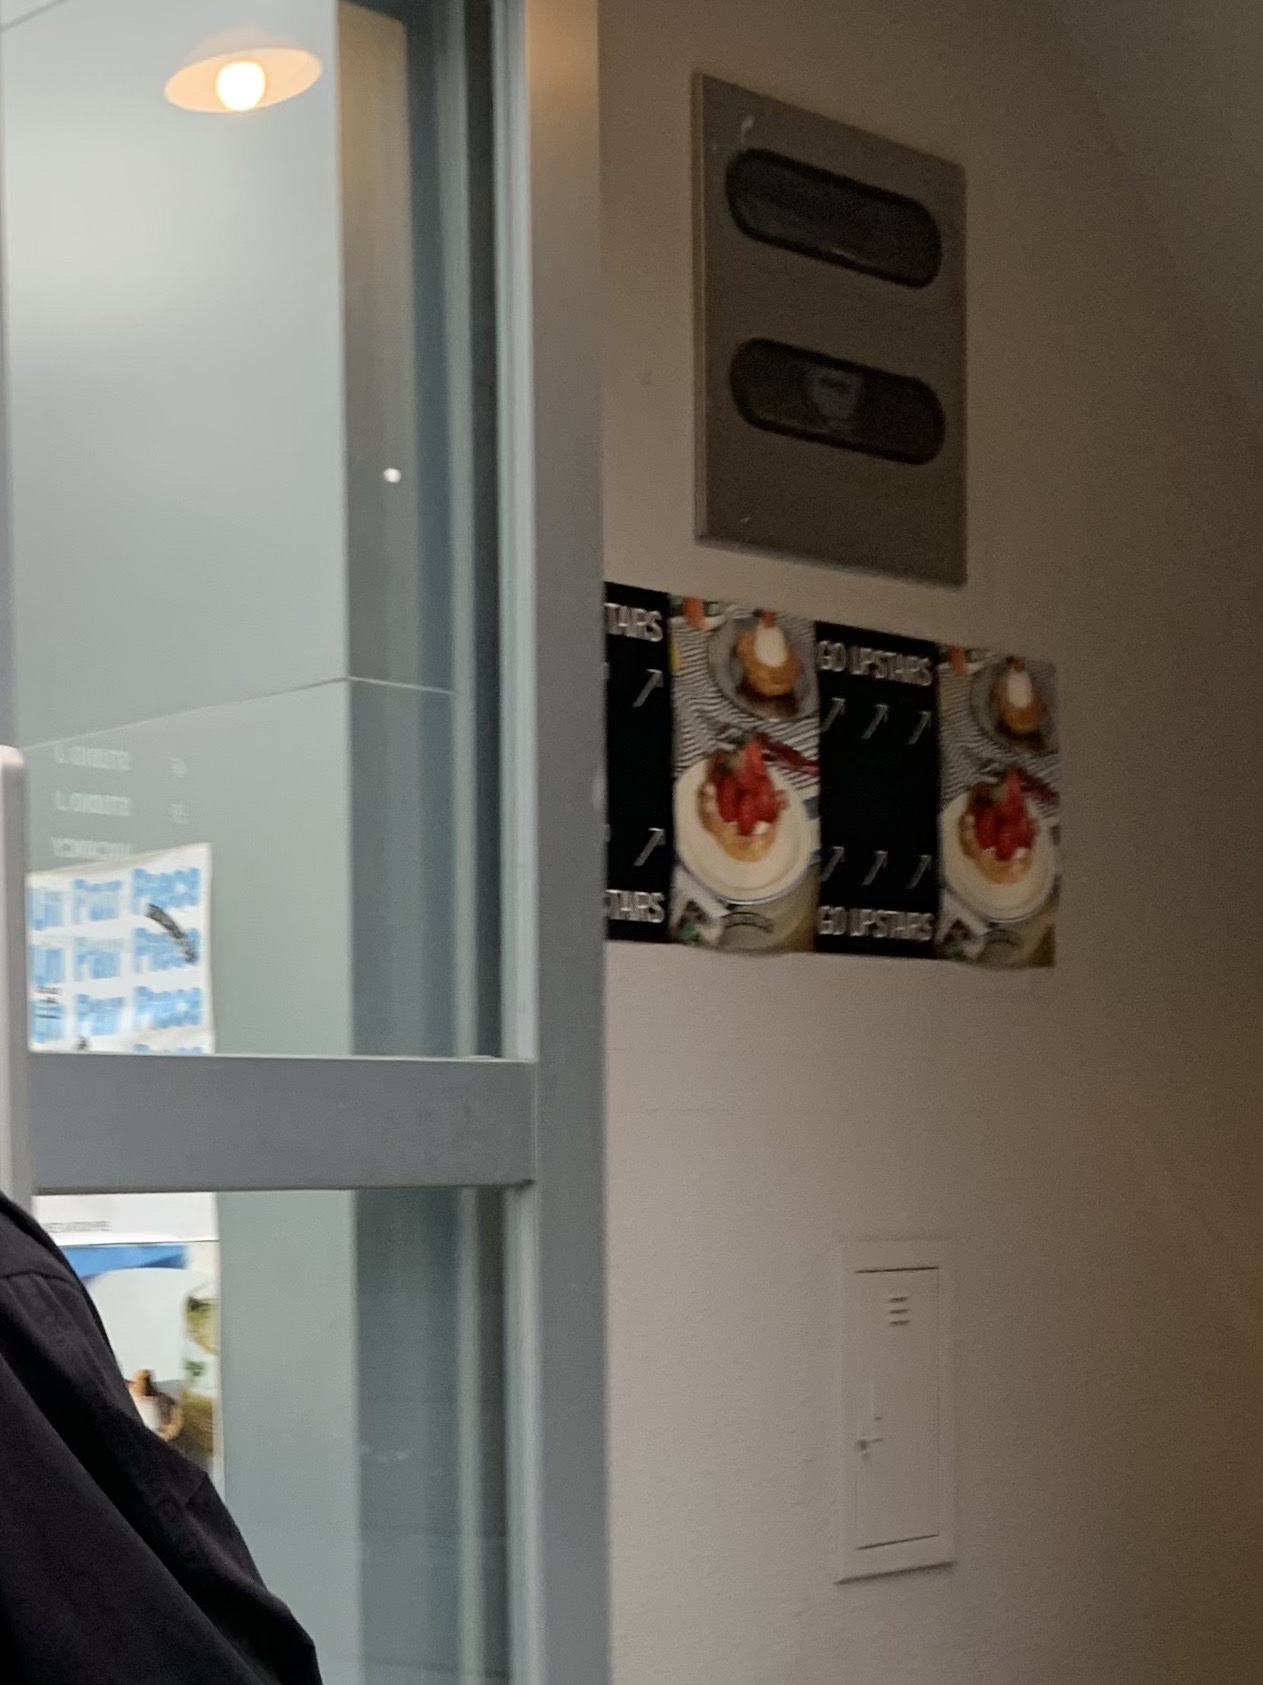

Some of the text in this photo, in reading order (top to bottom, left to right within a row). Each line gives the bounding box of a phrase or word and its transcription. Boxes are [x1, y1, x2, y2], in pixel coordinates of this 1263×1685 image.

[817, 640, 934, 687] GO UPSTAIRS
[817, 905, 934, 942] GO UPSTAIRS
